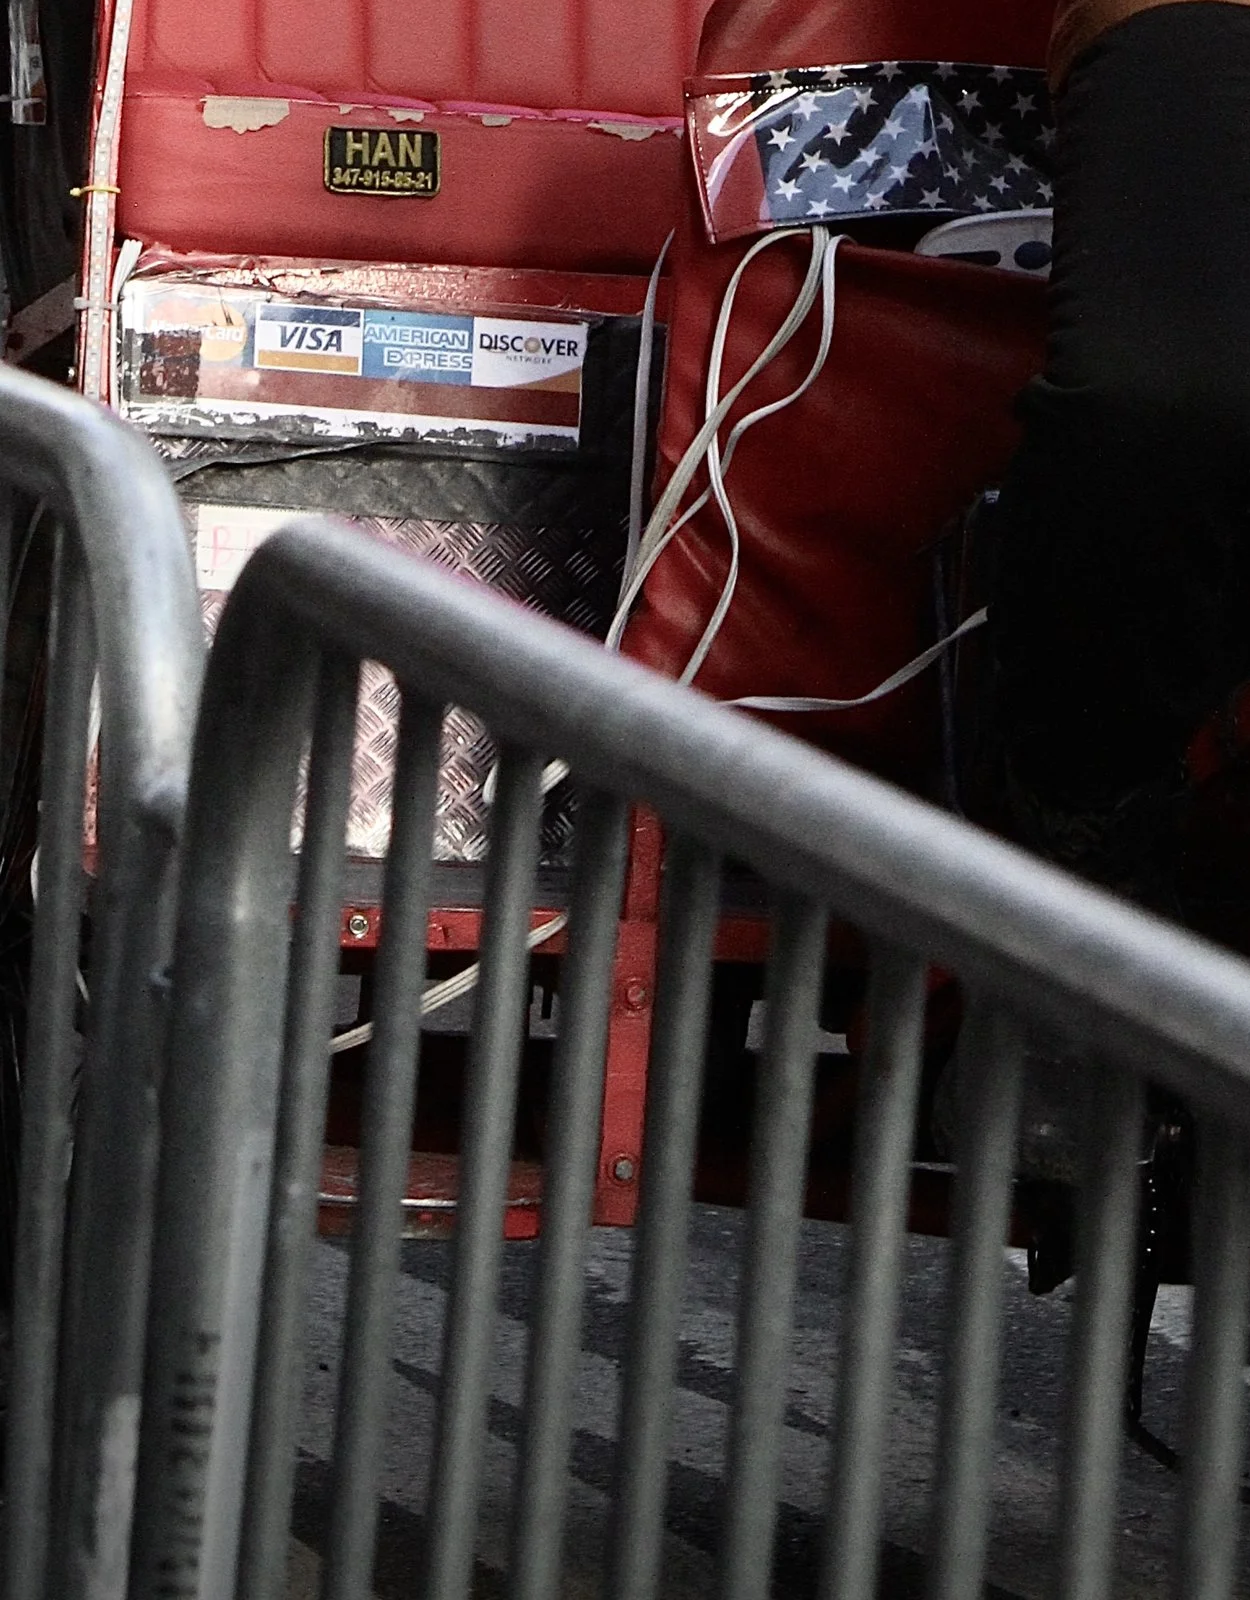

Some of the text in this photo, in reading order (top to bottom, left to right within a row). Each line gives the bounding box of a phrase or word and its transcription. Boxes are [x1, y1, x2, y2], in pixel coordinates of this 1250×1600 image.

[345, 130, 423, 168] HAN
[279, 325, 343, 352] VISA
[364, 325, 468, 348] AMERICAN
[479, 333, 579, 357] DISCOVER
[386, 350, 474, 370] EXPRESS
